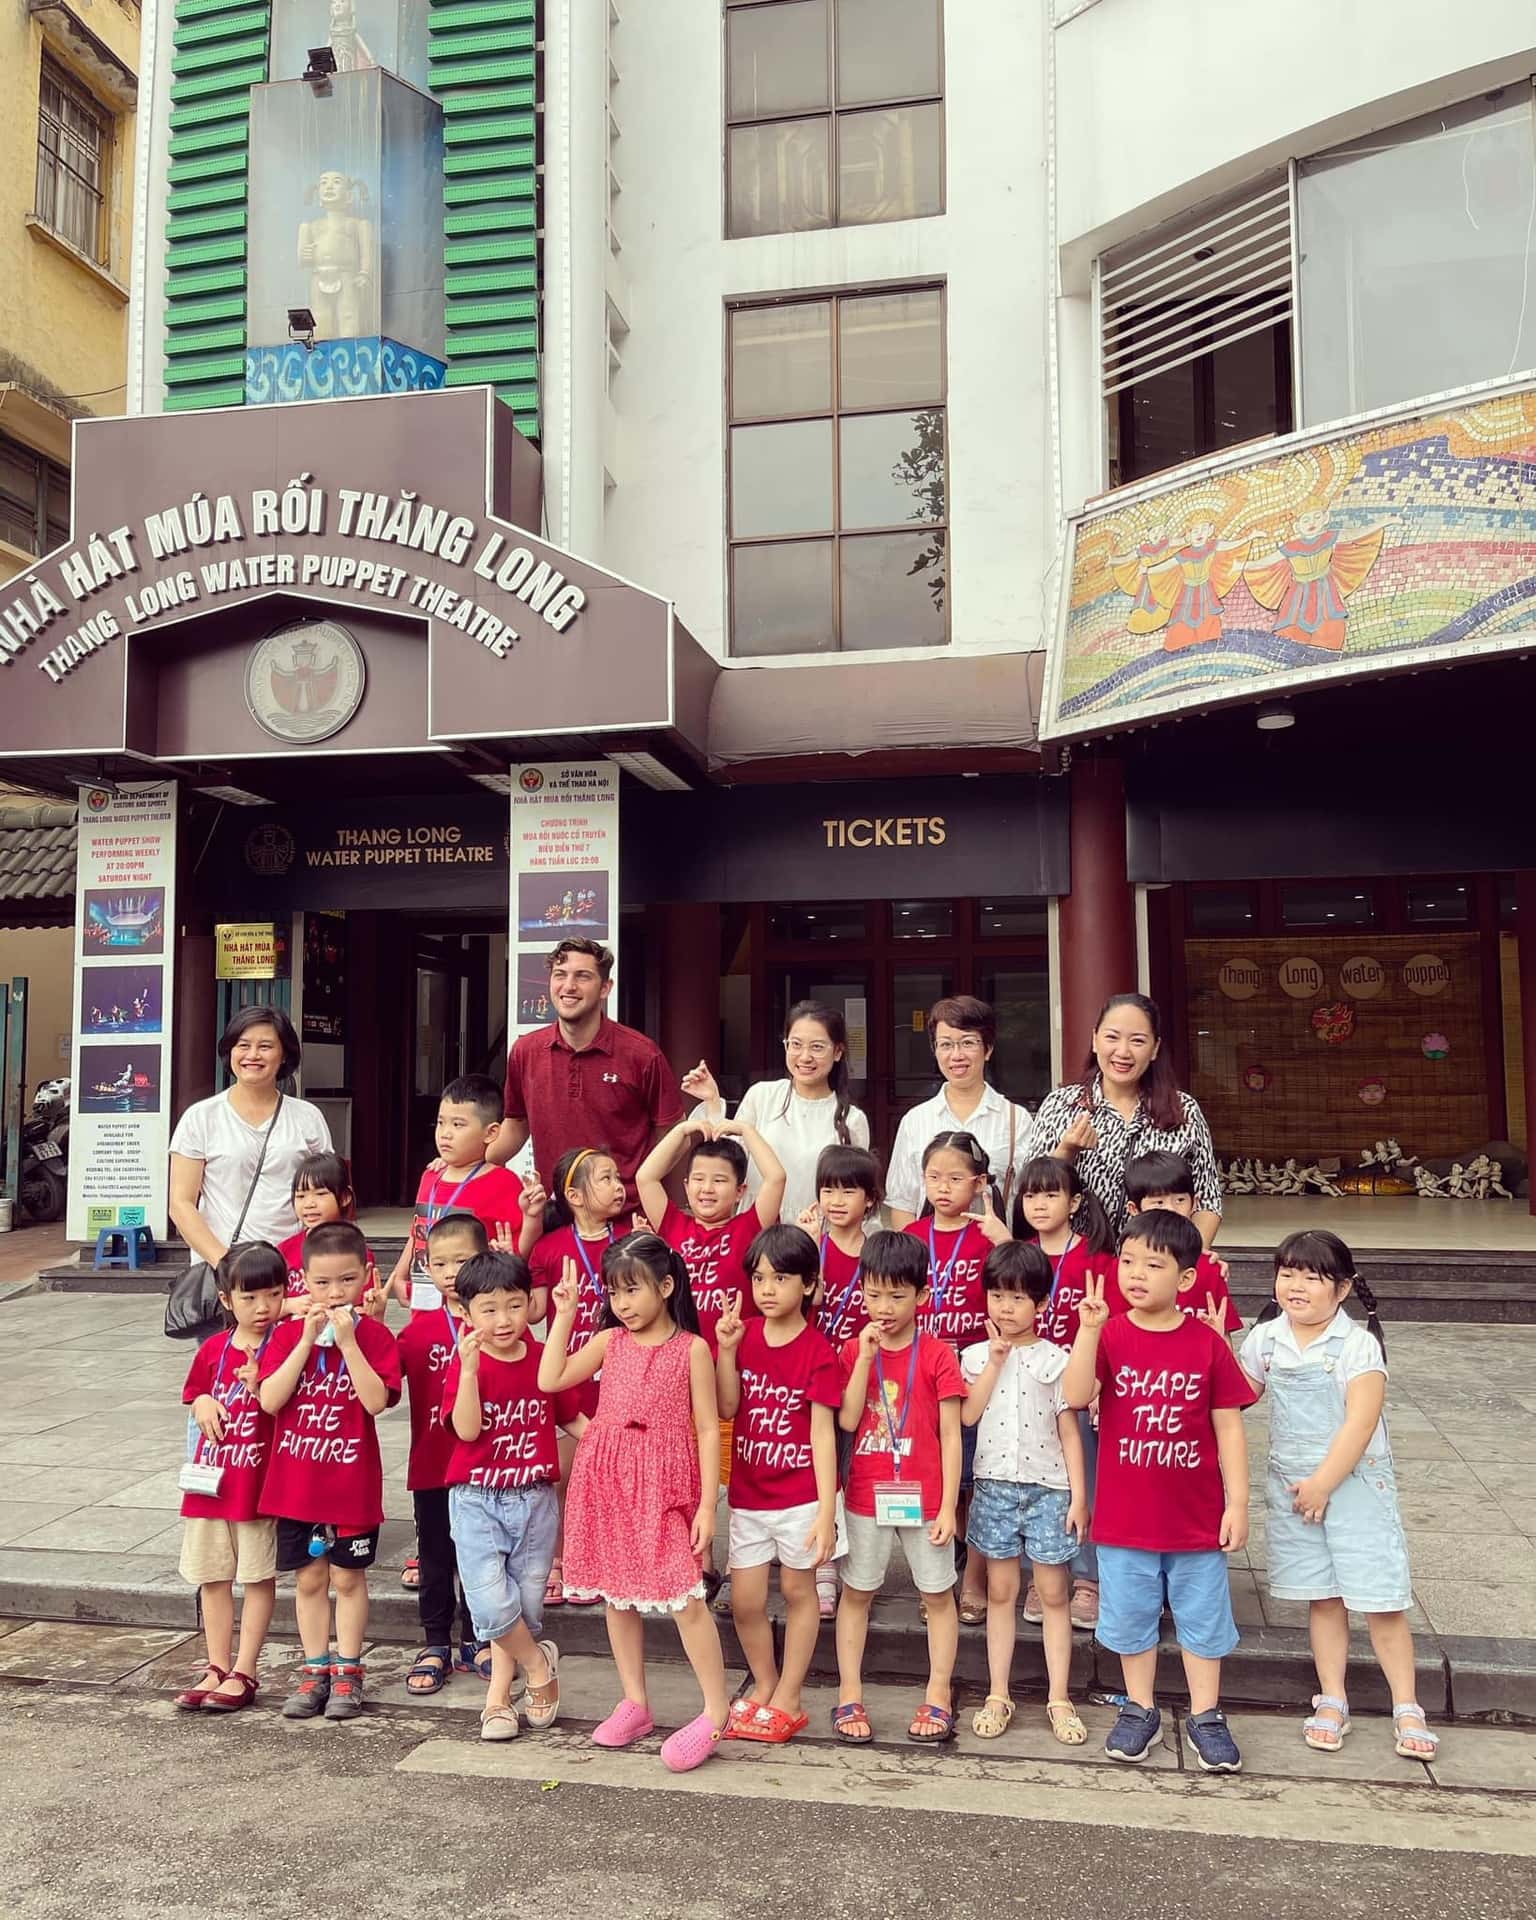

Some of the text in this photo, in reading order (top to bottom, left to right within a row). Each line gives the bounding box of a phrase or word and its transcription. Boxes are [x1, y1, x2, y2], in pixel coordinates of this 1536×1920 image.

[59, 526, 138, 600] HÁT
[144, 492, 244, 559] MÚA
[253, 473, 324, 536] RỐI
[338, 489, 474, 564] THĂNG
[473, 532, 585, 632] LONG
[38, 554, 519, 683] THANG LONG WATER PUPPET THEATRE
[92, 836, 161, 847] WATER PUPPET SHOW
[336, 826, 461, 846] THANG LONG
[823, 816, 946, 848] TICKETS
[91, 848, 160, 859] PERFORMING WEEKLY
[306, 846, 494, 867] WATER PUPPET THEATRE
[98, 872, 152, 883] SATURDAY NIGHT
[1223, 965, 1261, 989] Thang
[1285, 964, 1317, 990] Long
[1341, 963, 1383, 984] water
[686, 1261, 719, 1284] HE
[927, 1259, 980, 1283] HAPE
[1036, 1313, 1069, 1338] HE
[1115, 1366, 1202, 1401] SHAPE
[223, 1410, 258, 1438] HE
[297, 1404, 344, 1432] THE
[481, 1399, 547, 1431] SHAPE
[748, 1408, 793, 1436] THE
[1132, 1404, 1183, 1434] THE
[278, 1430, 361, 1464] FUTURE
[492, 1431, 538, 1460] THE
[736, 1436, 811, 1469] FUTURE
[1119, 1437, 1200, 1469] FUTURE
